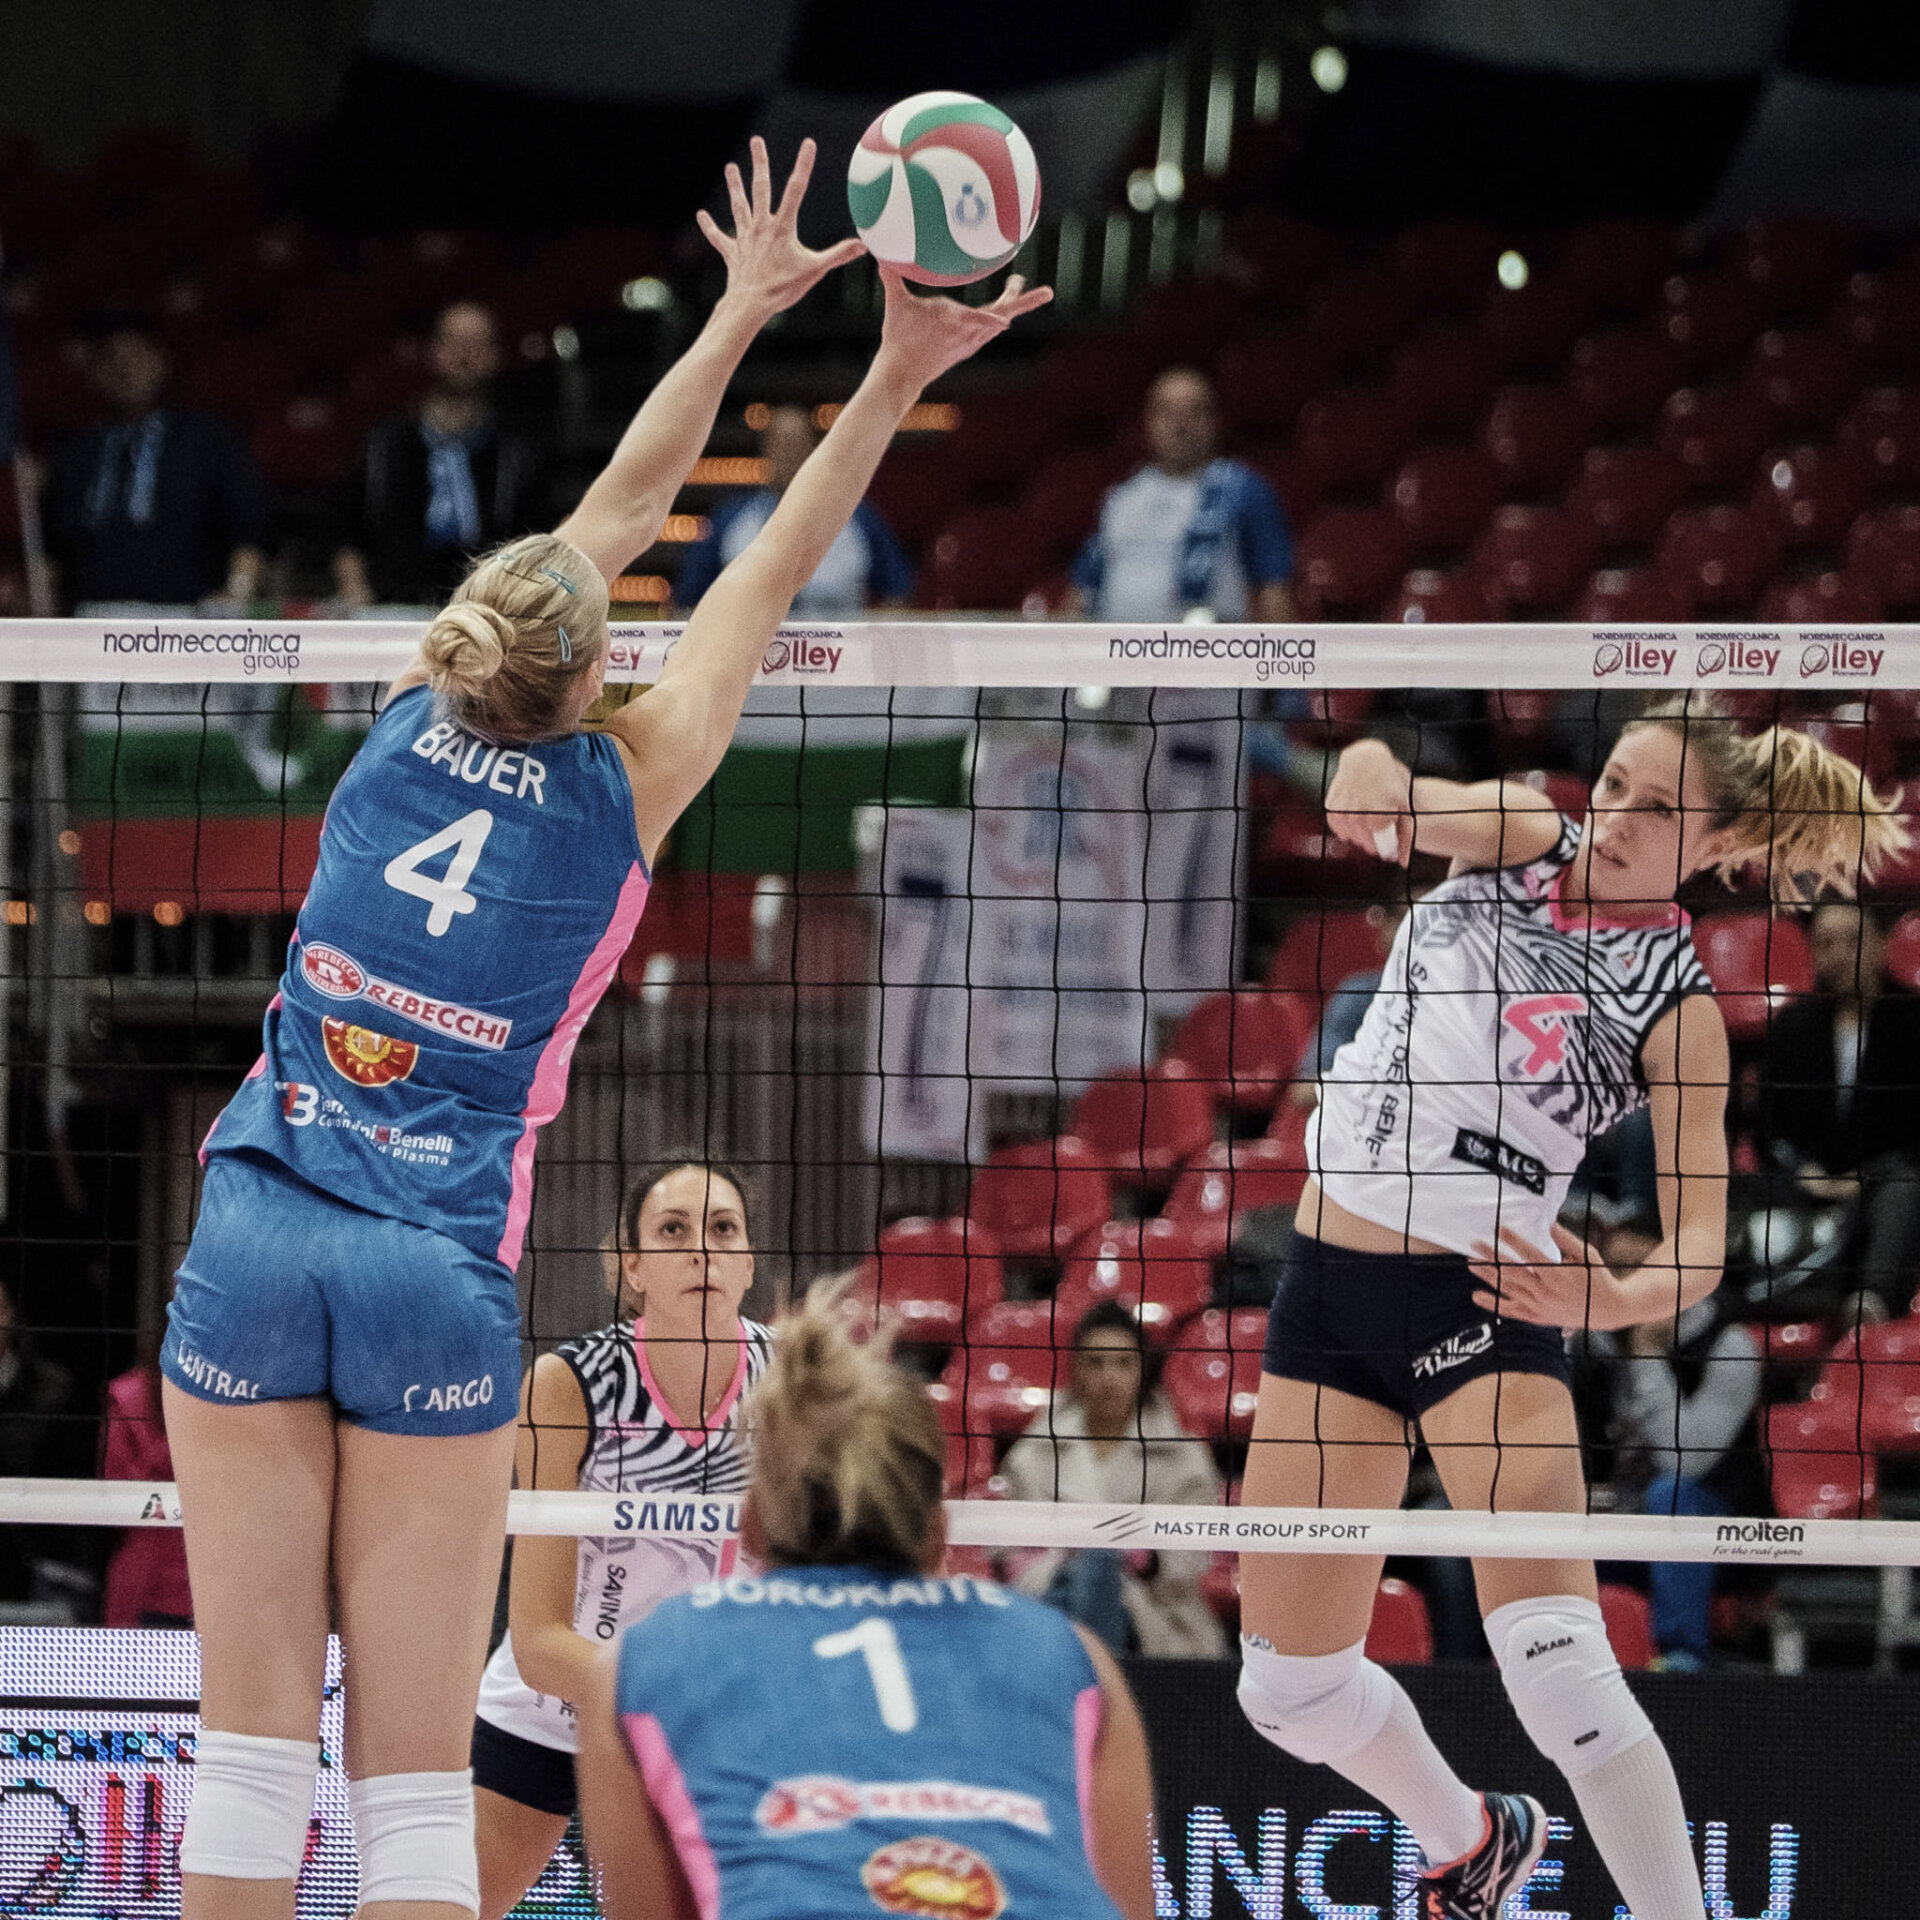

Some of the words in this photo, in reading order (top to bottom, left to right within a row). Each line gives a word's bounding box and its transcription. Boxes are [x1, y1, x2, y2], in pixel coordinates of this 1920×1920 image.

[103, 626, 301, 653] nordmeccanica
[1108, 630, 1316, 659] nordmeccanica
[1592, 631, 1677, 640] NORDMECCANICA
[1696, 631, 1781, 640] NORDMECCANICA
[1800, 632, 1885, 641] NORDMECCANICA
[243, 653, 301, 675] group
[1256, 659, 1316, 681] group
[411, 721, 546, 805] BAUER
[384, 808, 493, 937] 4
[366, 984, 508, 1045] REBECCHI
[1503, 993, 1588, 1077] 4
[389, 1127, 454, 1153] Benelli
[392, 1149, 449, 1166] Plasma
[1154, 1521, 1230, 1537] MASTER
[1236, 1522, 1303, 1538] GROUP
[1308, 1523, 1370, 1539] SPORT
[1717, 1521, 1804, 1542] molten
[595, 1563, 627, 1640] SAVINO
[812, 1616, 918, 1733] 1
